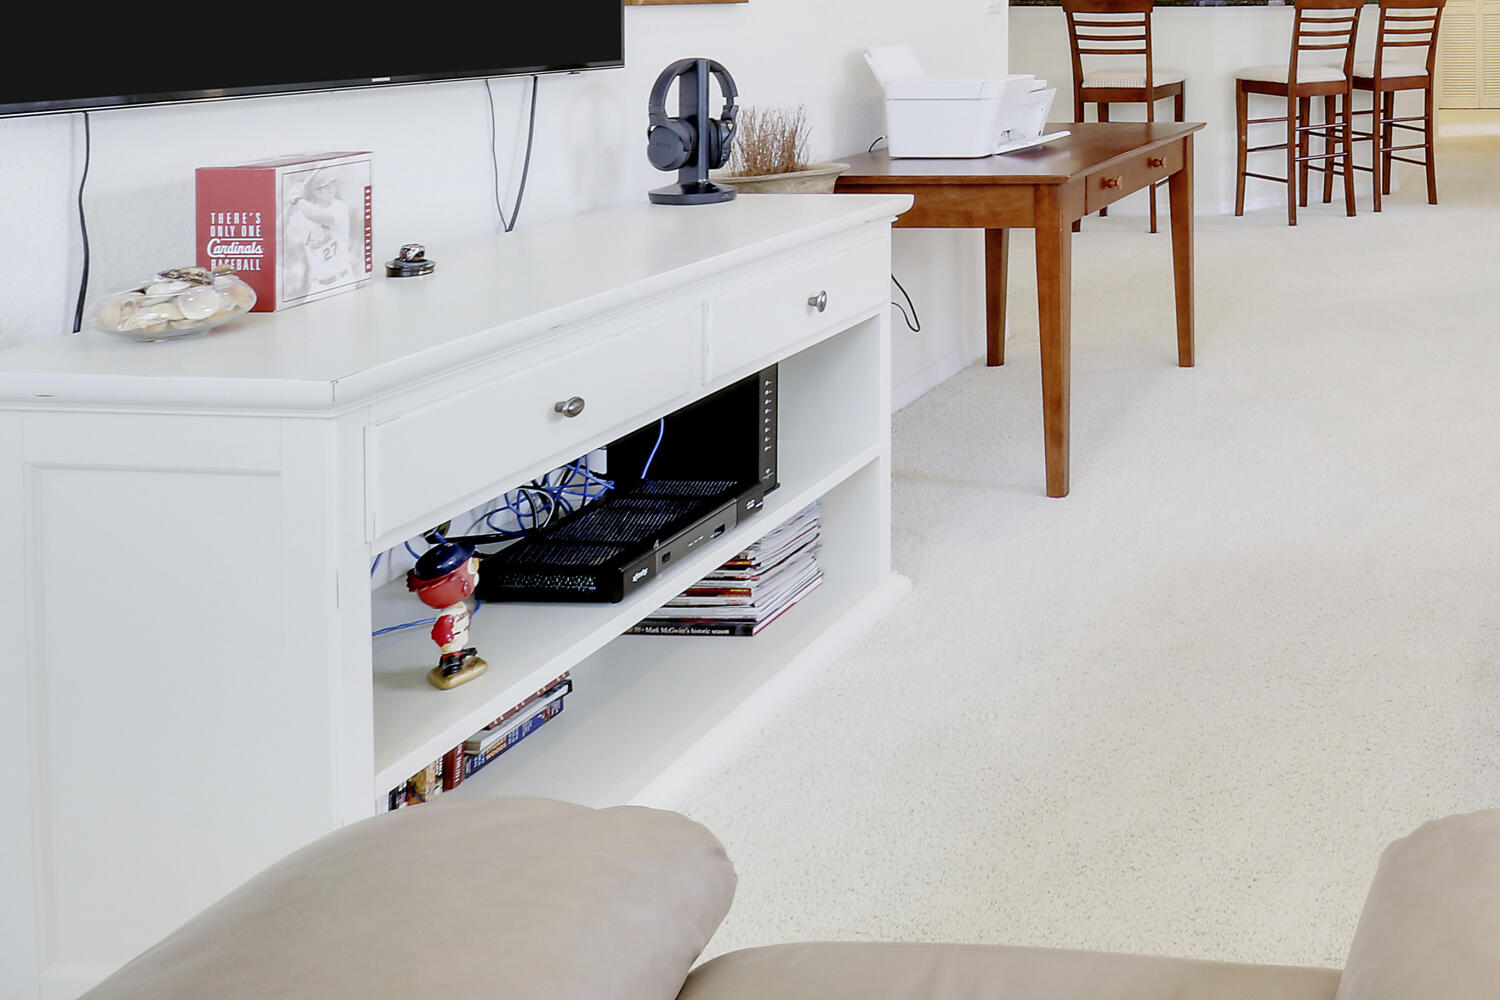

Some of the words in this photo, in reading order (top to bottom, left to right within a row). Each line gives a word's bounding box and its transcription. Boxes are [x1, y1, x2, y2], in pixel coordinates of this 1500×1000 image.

[210, 212, 261, 225] THERE'S
[210, 225, 235, 237] ONLY
[241, 225, 261, 237] ONE
[207, 238, 264, 258] Cardinals
[323, 241, 337, 260] 27
